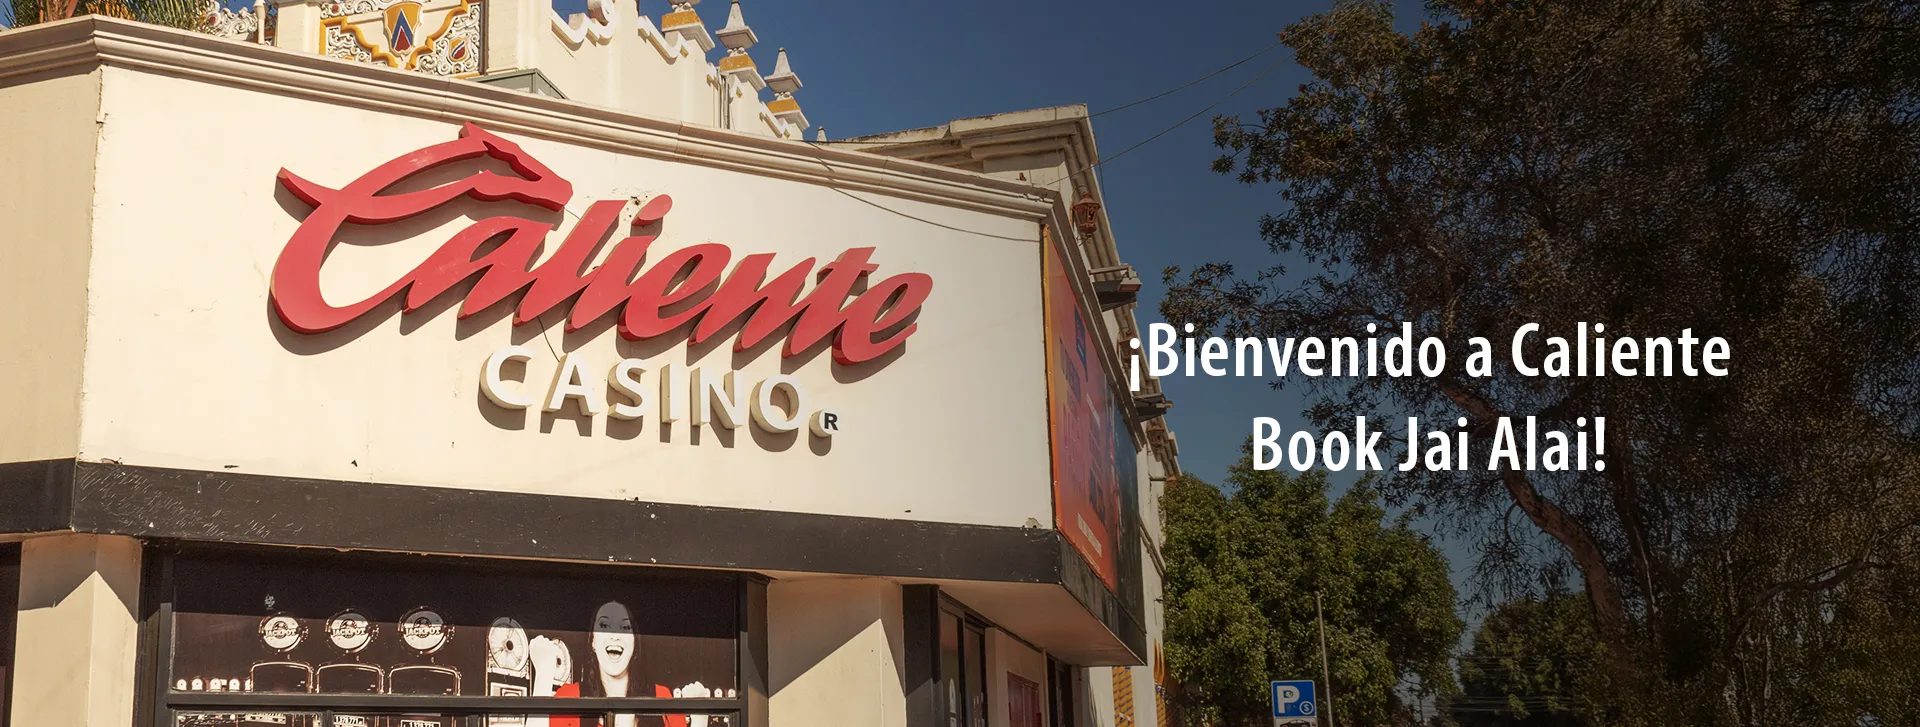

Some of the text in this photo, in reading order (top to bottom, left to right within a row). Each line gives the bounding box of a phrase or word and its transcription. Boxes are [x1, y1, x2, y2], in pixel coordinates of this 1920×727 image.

[270, 121, 933, 365] Caliente
[480, 347, 808, 434] CASINO
[264, 628, 298, 638] JACKPOT
[332, 627, 366, 638] JACKPOT
[404, 626, 442, 638] JACKPOT
[1276, 685, 1300, 714] P
